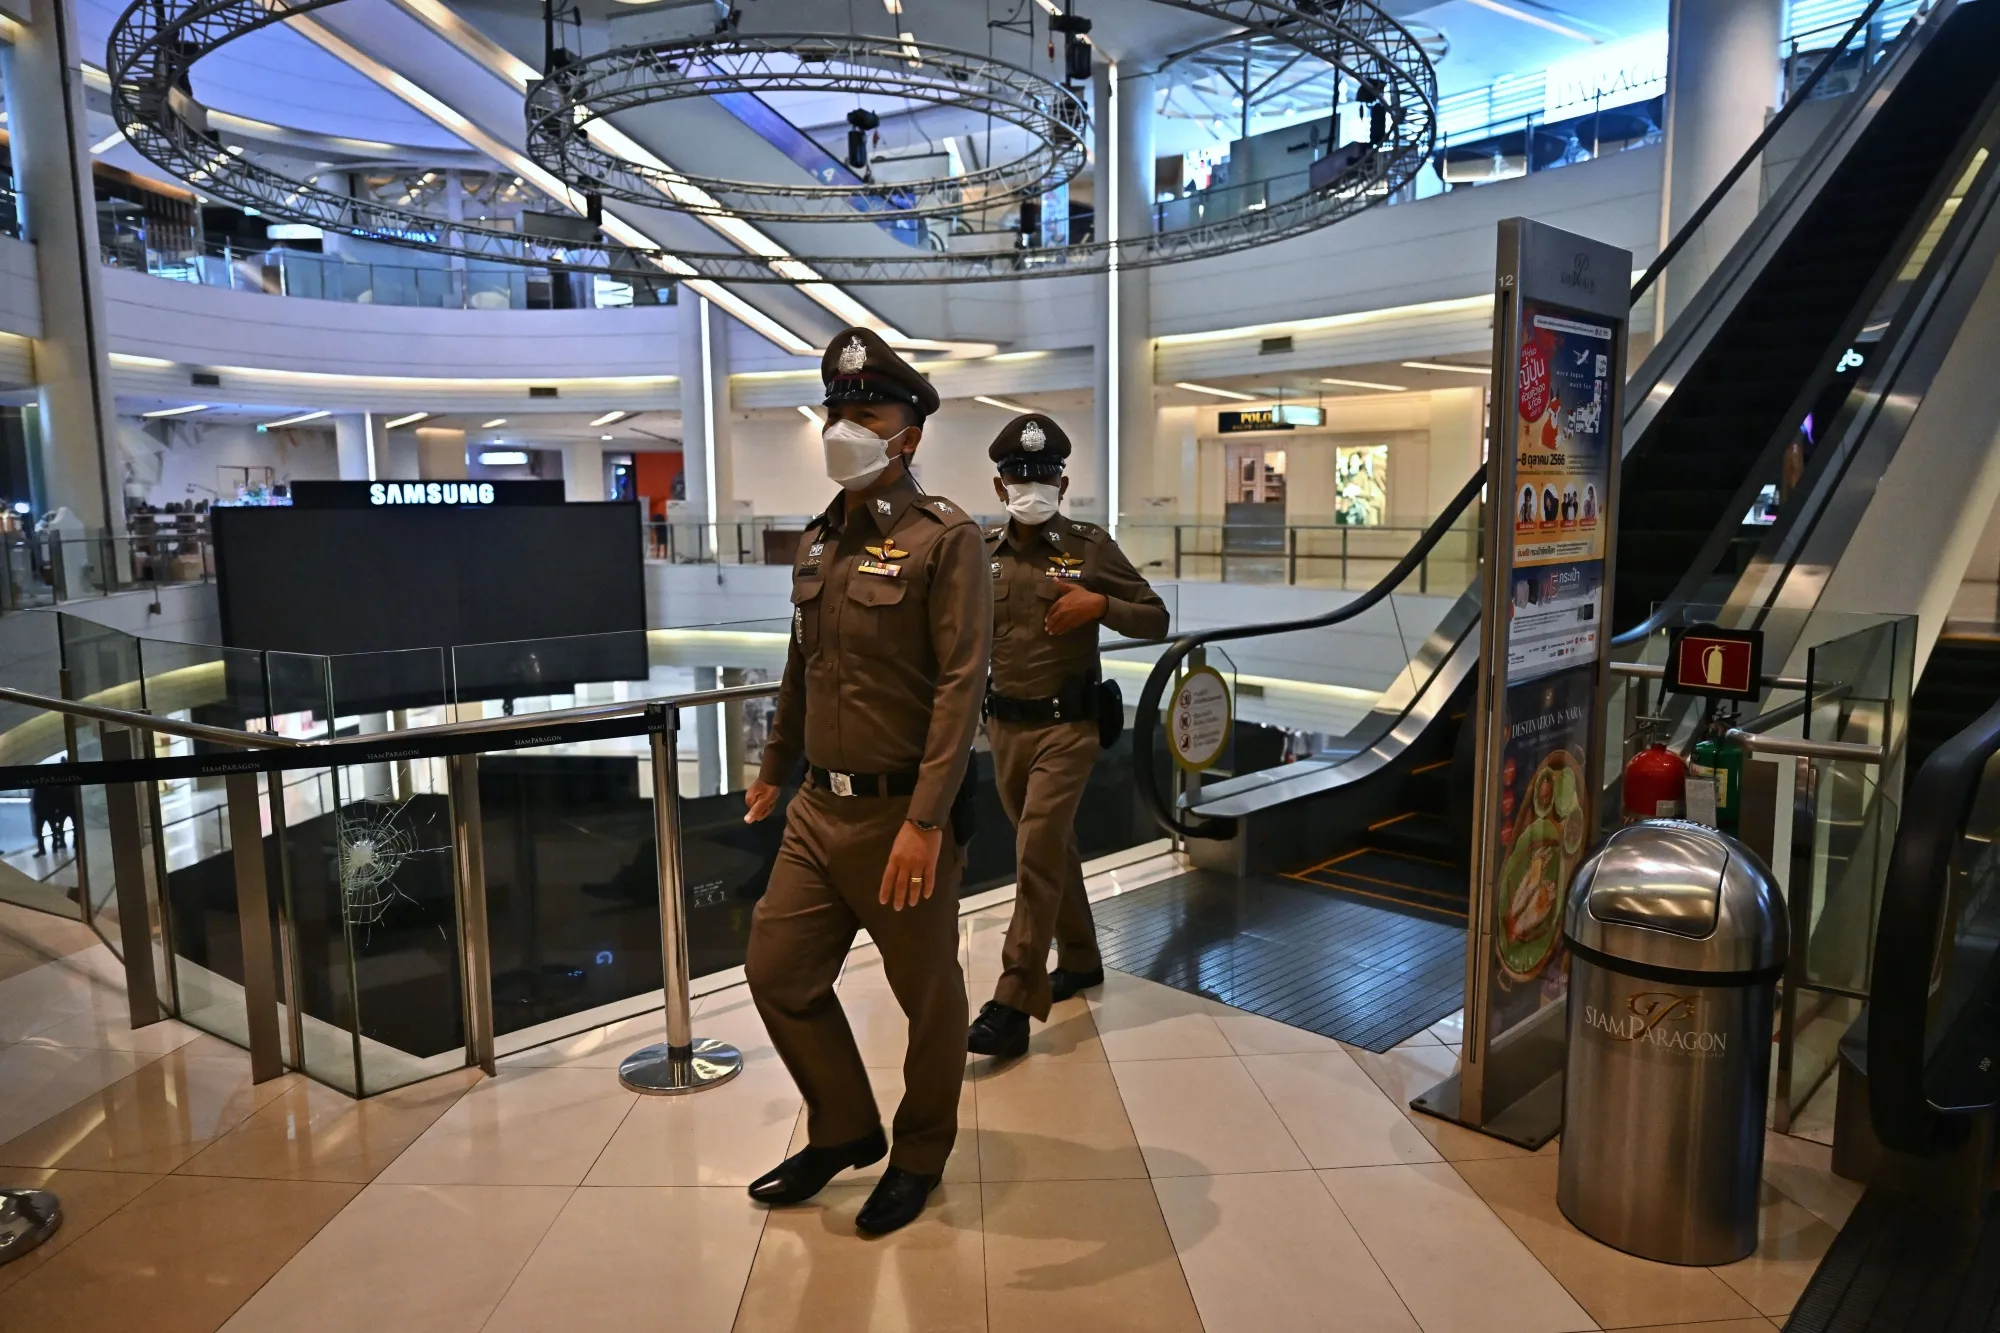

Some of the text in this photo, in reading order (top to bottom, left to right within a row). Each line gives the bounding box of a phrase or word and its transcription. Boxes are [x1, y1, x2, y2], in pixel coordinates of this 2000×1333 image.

[1499, 274, 1514, 288] 12
[1240, 411, 1272, 424] POLO
[1549, 453, 1566, 466] 2566
[370, 483, 495, 505] SAMSUNG
[1512, 713, 1555, 739] DESTINATION
[514, 735, 561, 746] SIAMPARAGON
[366, 749, 419, 760] SIAMPARAGON
[201, 763, 260, 773] SIAMPARAGON
